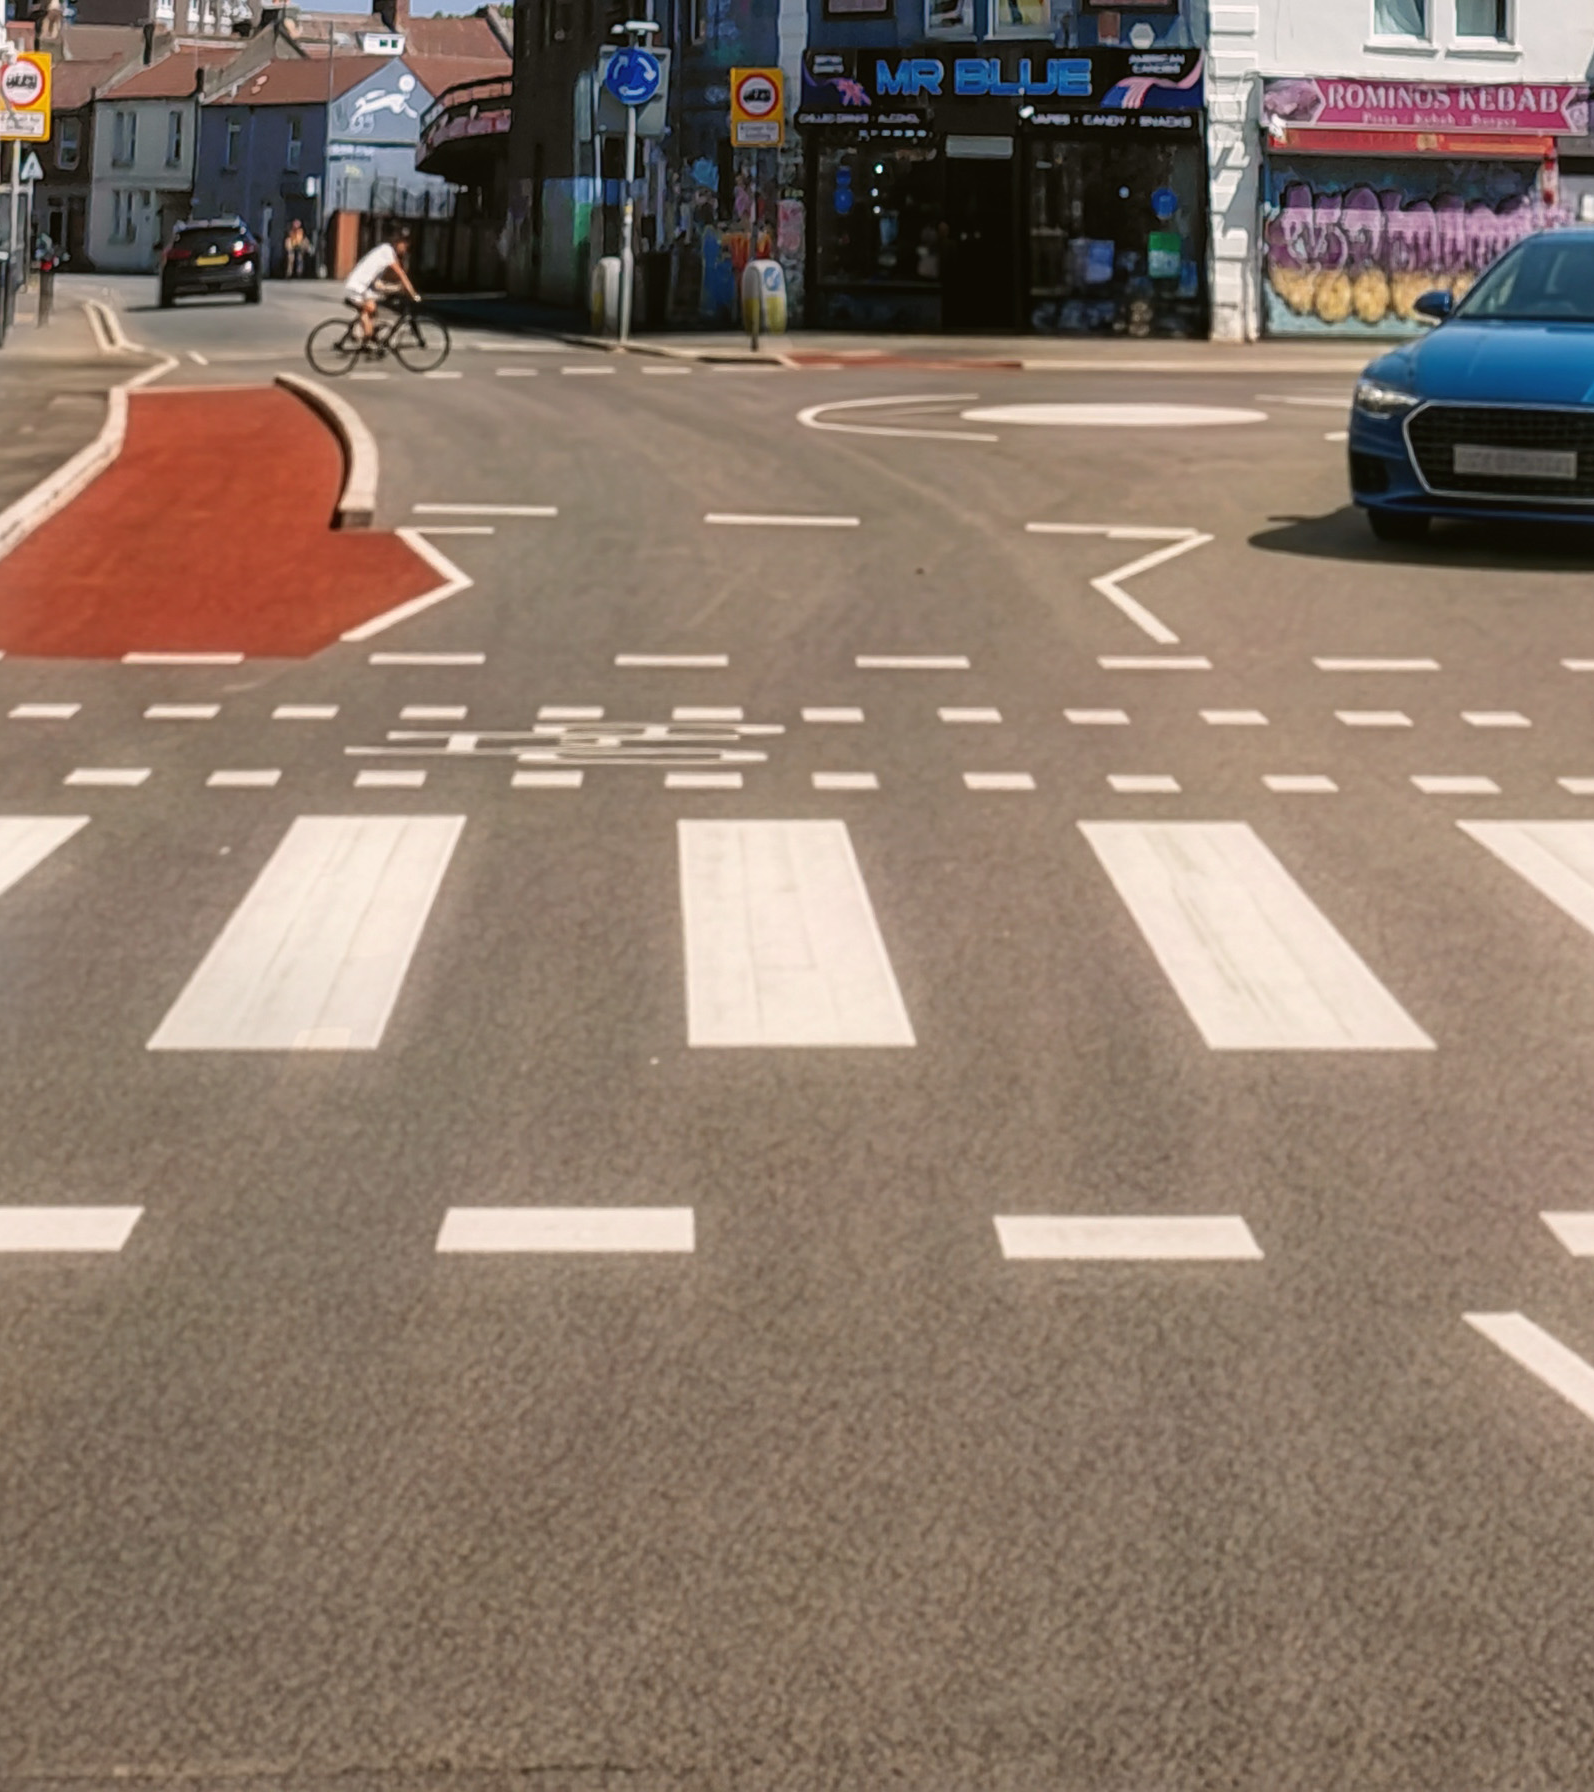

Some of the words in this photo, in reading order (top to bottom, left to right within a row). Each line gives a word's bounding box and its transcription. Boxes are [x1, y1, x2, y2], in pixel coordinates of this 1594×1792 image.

[876, 59, 944, 96] MR
[954, 58, 1093, 97] BLUE
[1459, 87, 1558, 114] KEBAB
